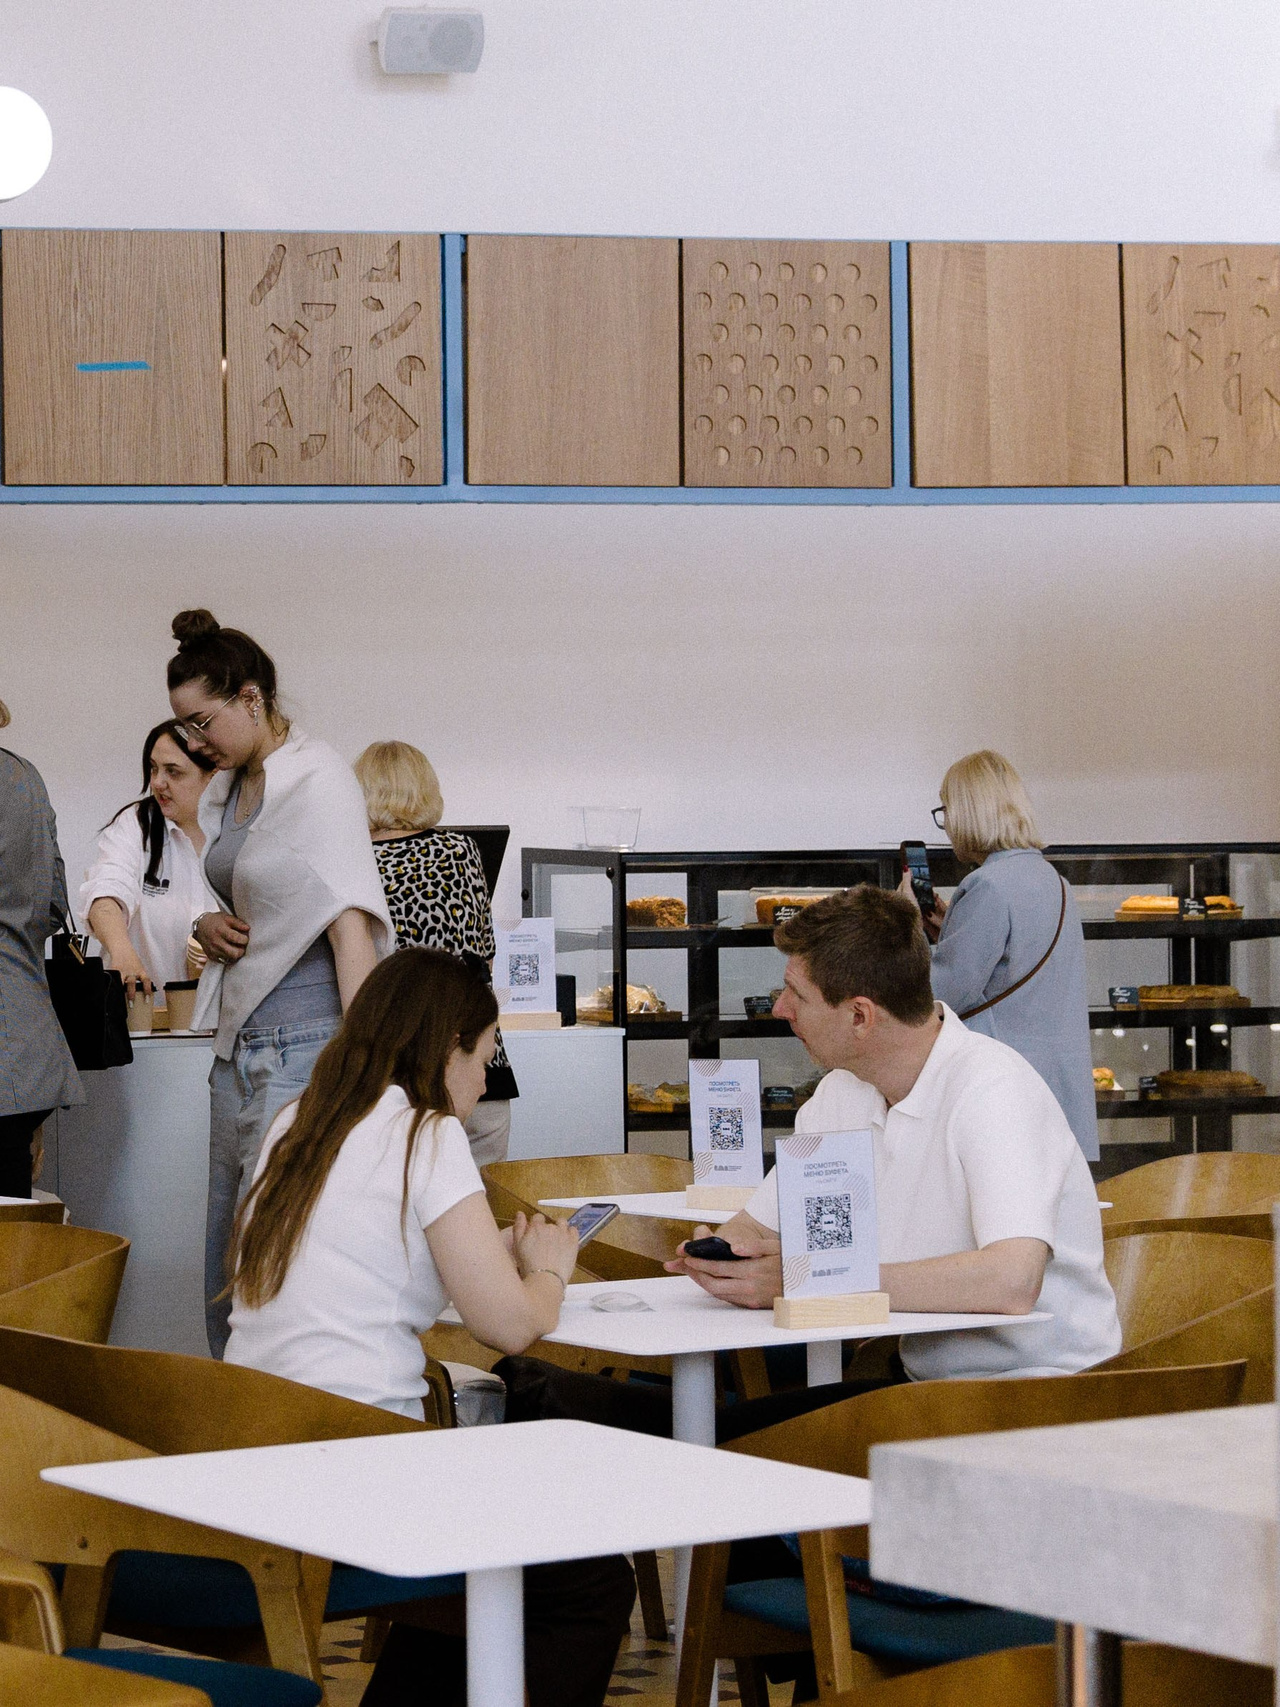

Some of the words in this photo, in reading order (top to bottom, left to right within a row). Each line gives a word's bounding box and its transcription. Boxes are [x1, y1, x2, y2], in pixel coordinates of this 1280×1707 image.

[804, 1161, 848, 1170] ПОСМОТРЕТЬ
[803, 1170, 824, 1178] МЕНЮ
[825, 1168, 849, 1176] БУФЕТА
